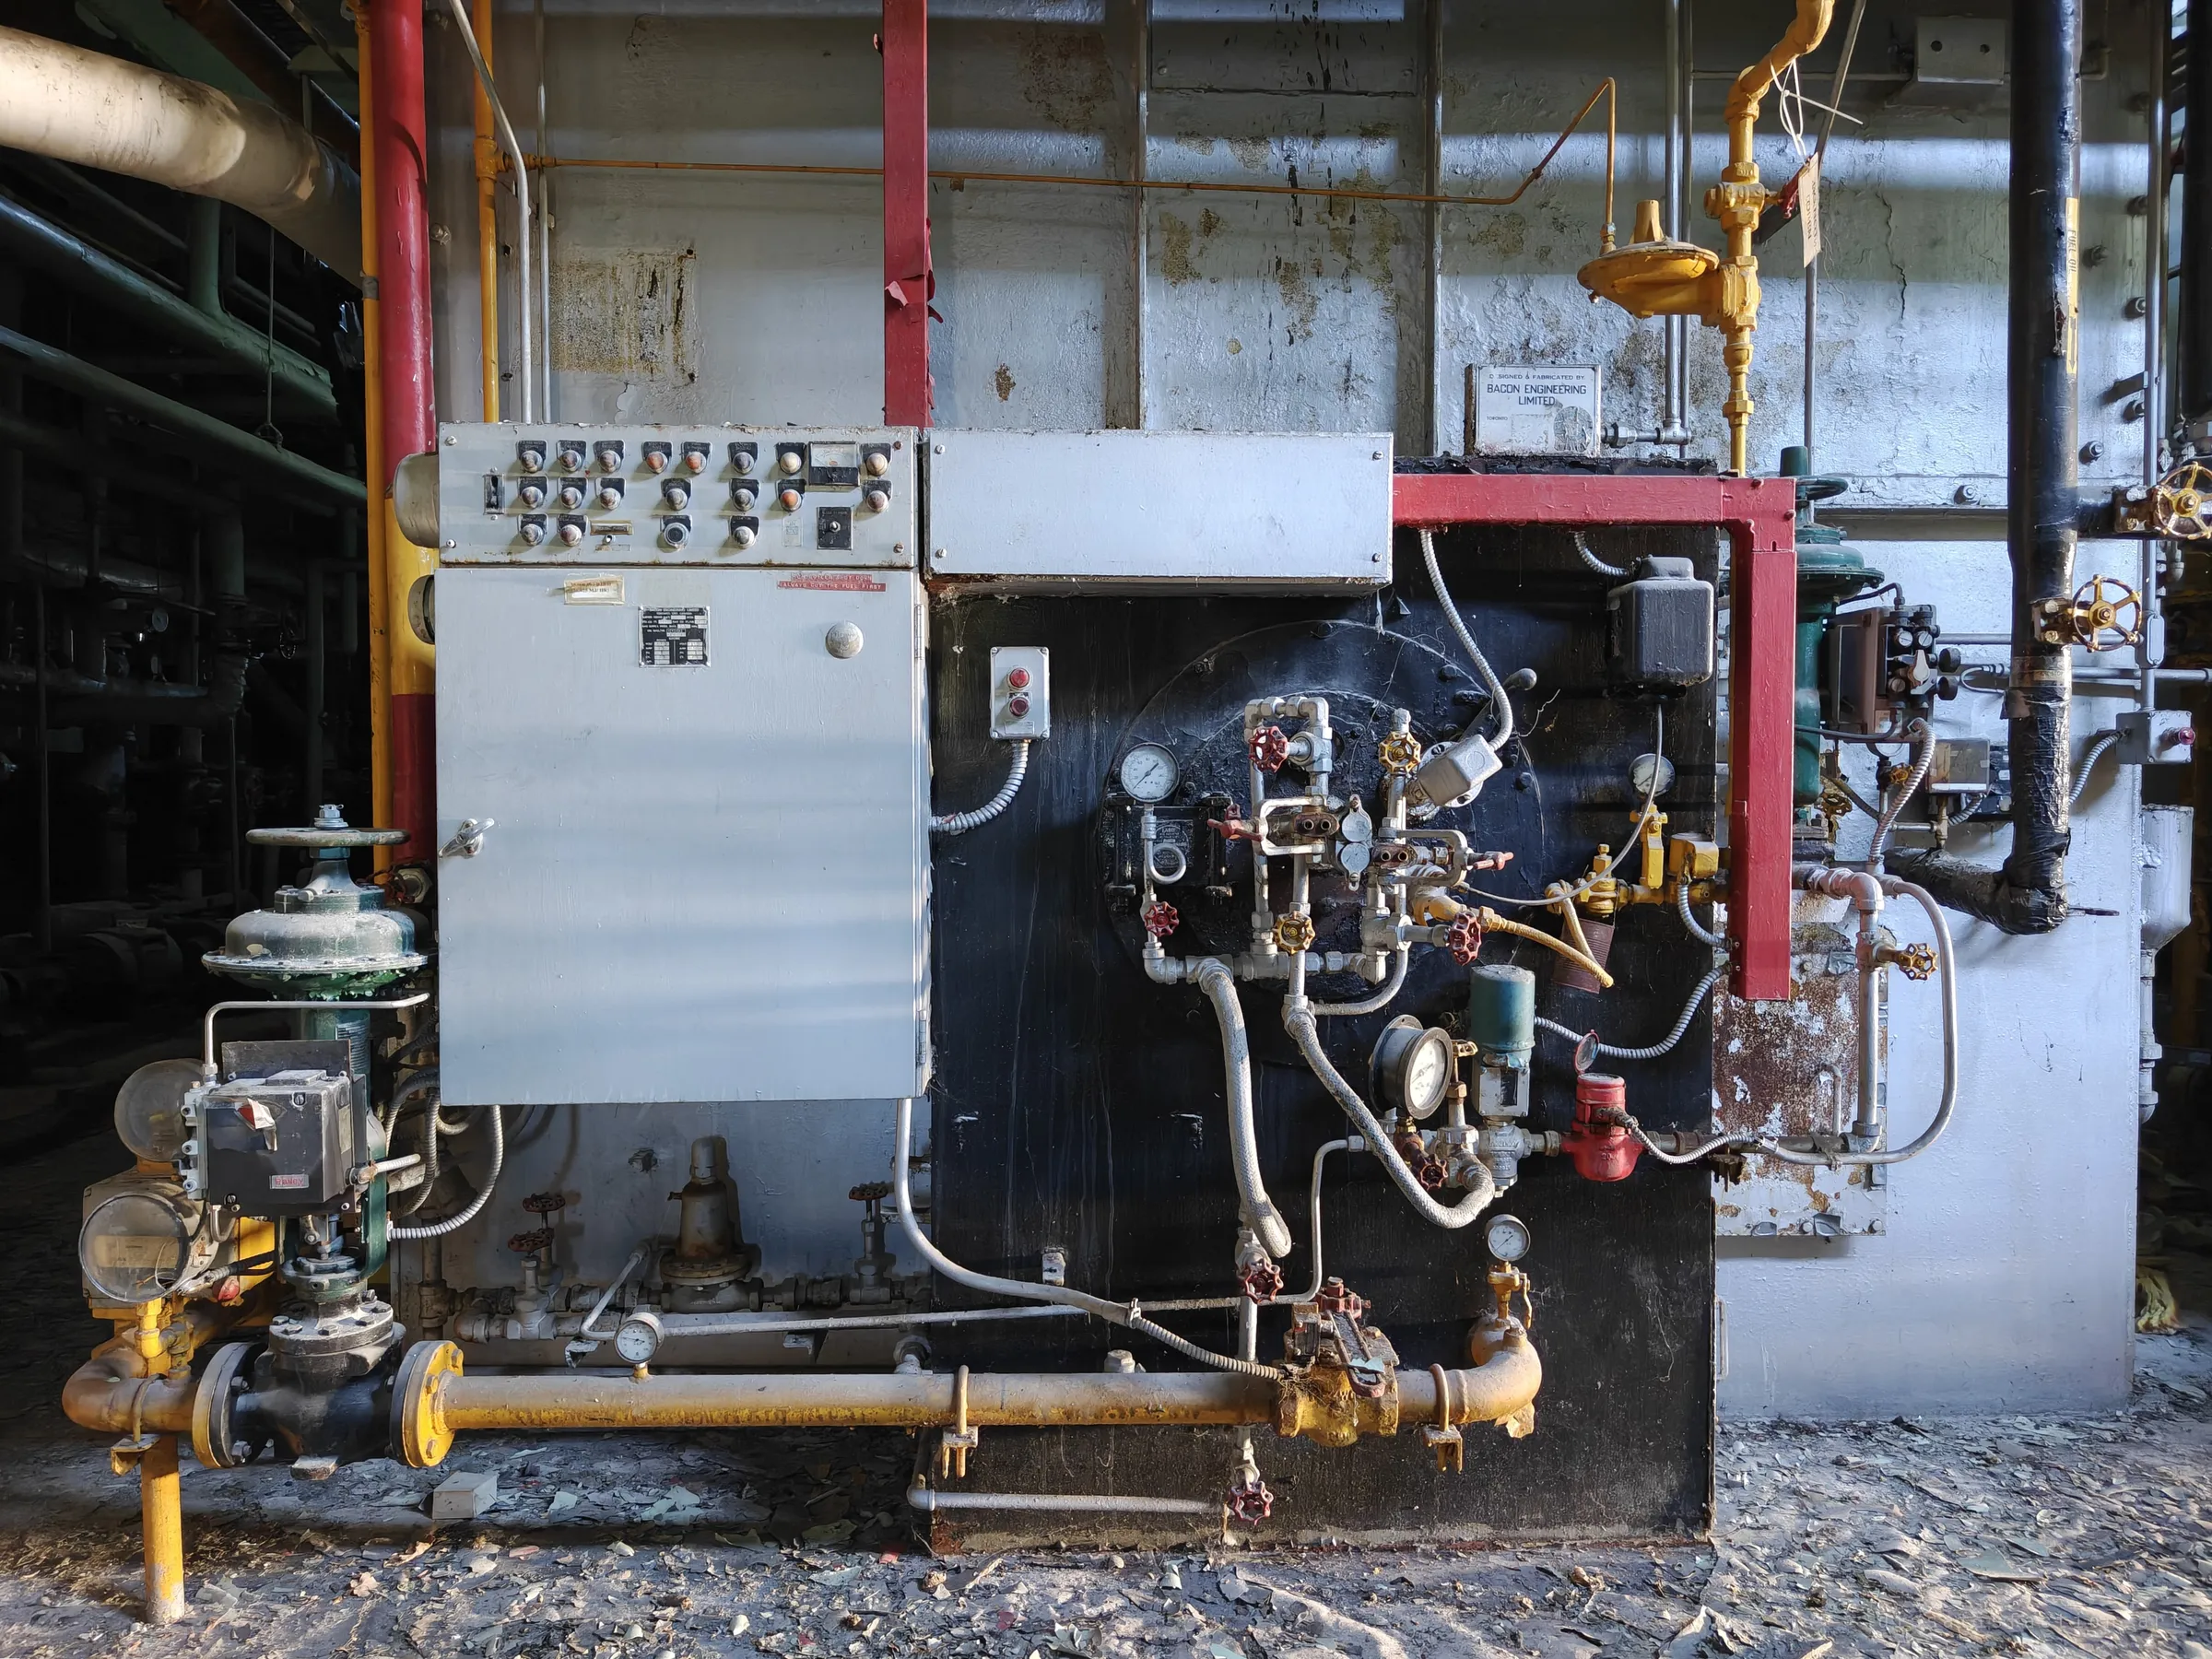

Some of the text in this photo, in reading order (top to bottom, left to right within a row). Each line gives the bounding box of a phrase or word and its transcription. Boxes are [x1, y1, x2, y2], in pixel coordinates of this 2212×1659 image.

[2067, 229, 2077, 273] FUEL OIL
[1487, 383, 1587, 394] BACON ENGINEERING
[1518, 395, 1556, 406] LIMITED
